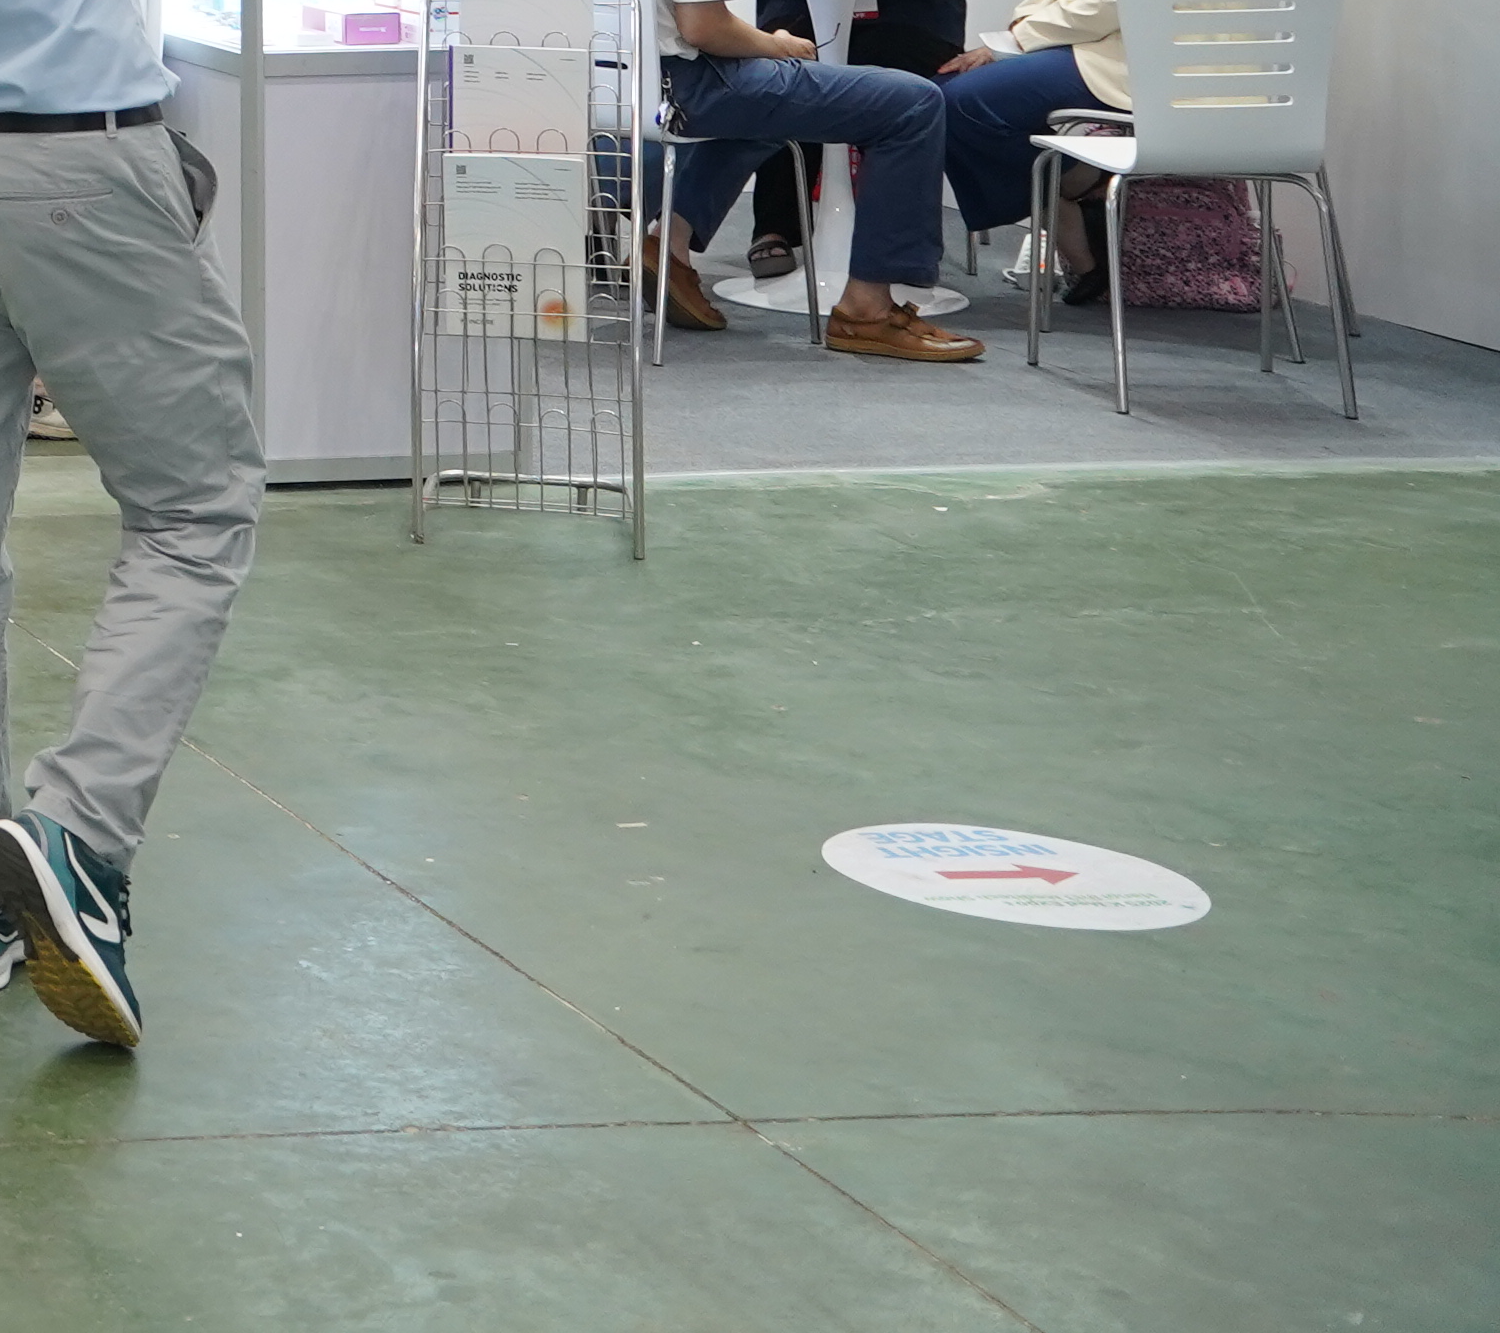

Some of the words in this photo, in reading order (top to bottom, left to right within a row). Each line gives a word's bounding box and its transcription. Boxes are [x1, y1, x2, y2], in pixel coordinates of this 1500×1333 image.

[458, 271, 523, 282] DIAGNOSTIC
[458, 282, 518, 293] SOLUTIONS
[878, 845, 1057, 859] INSIGHT
